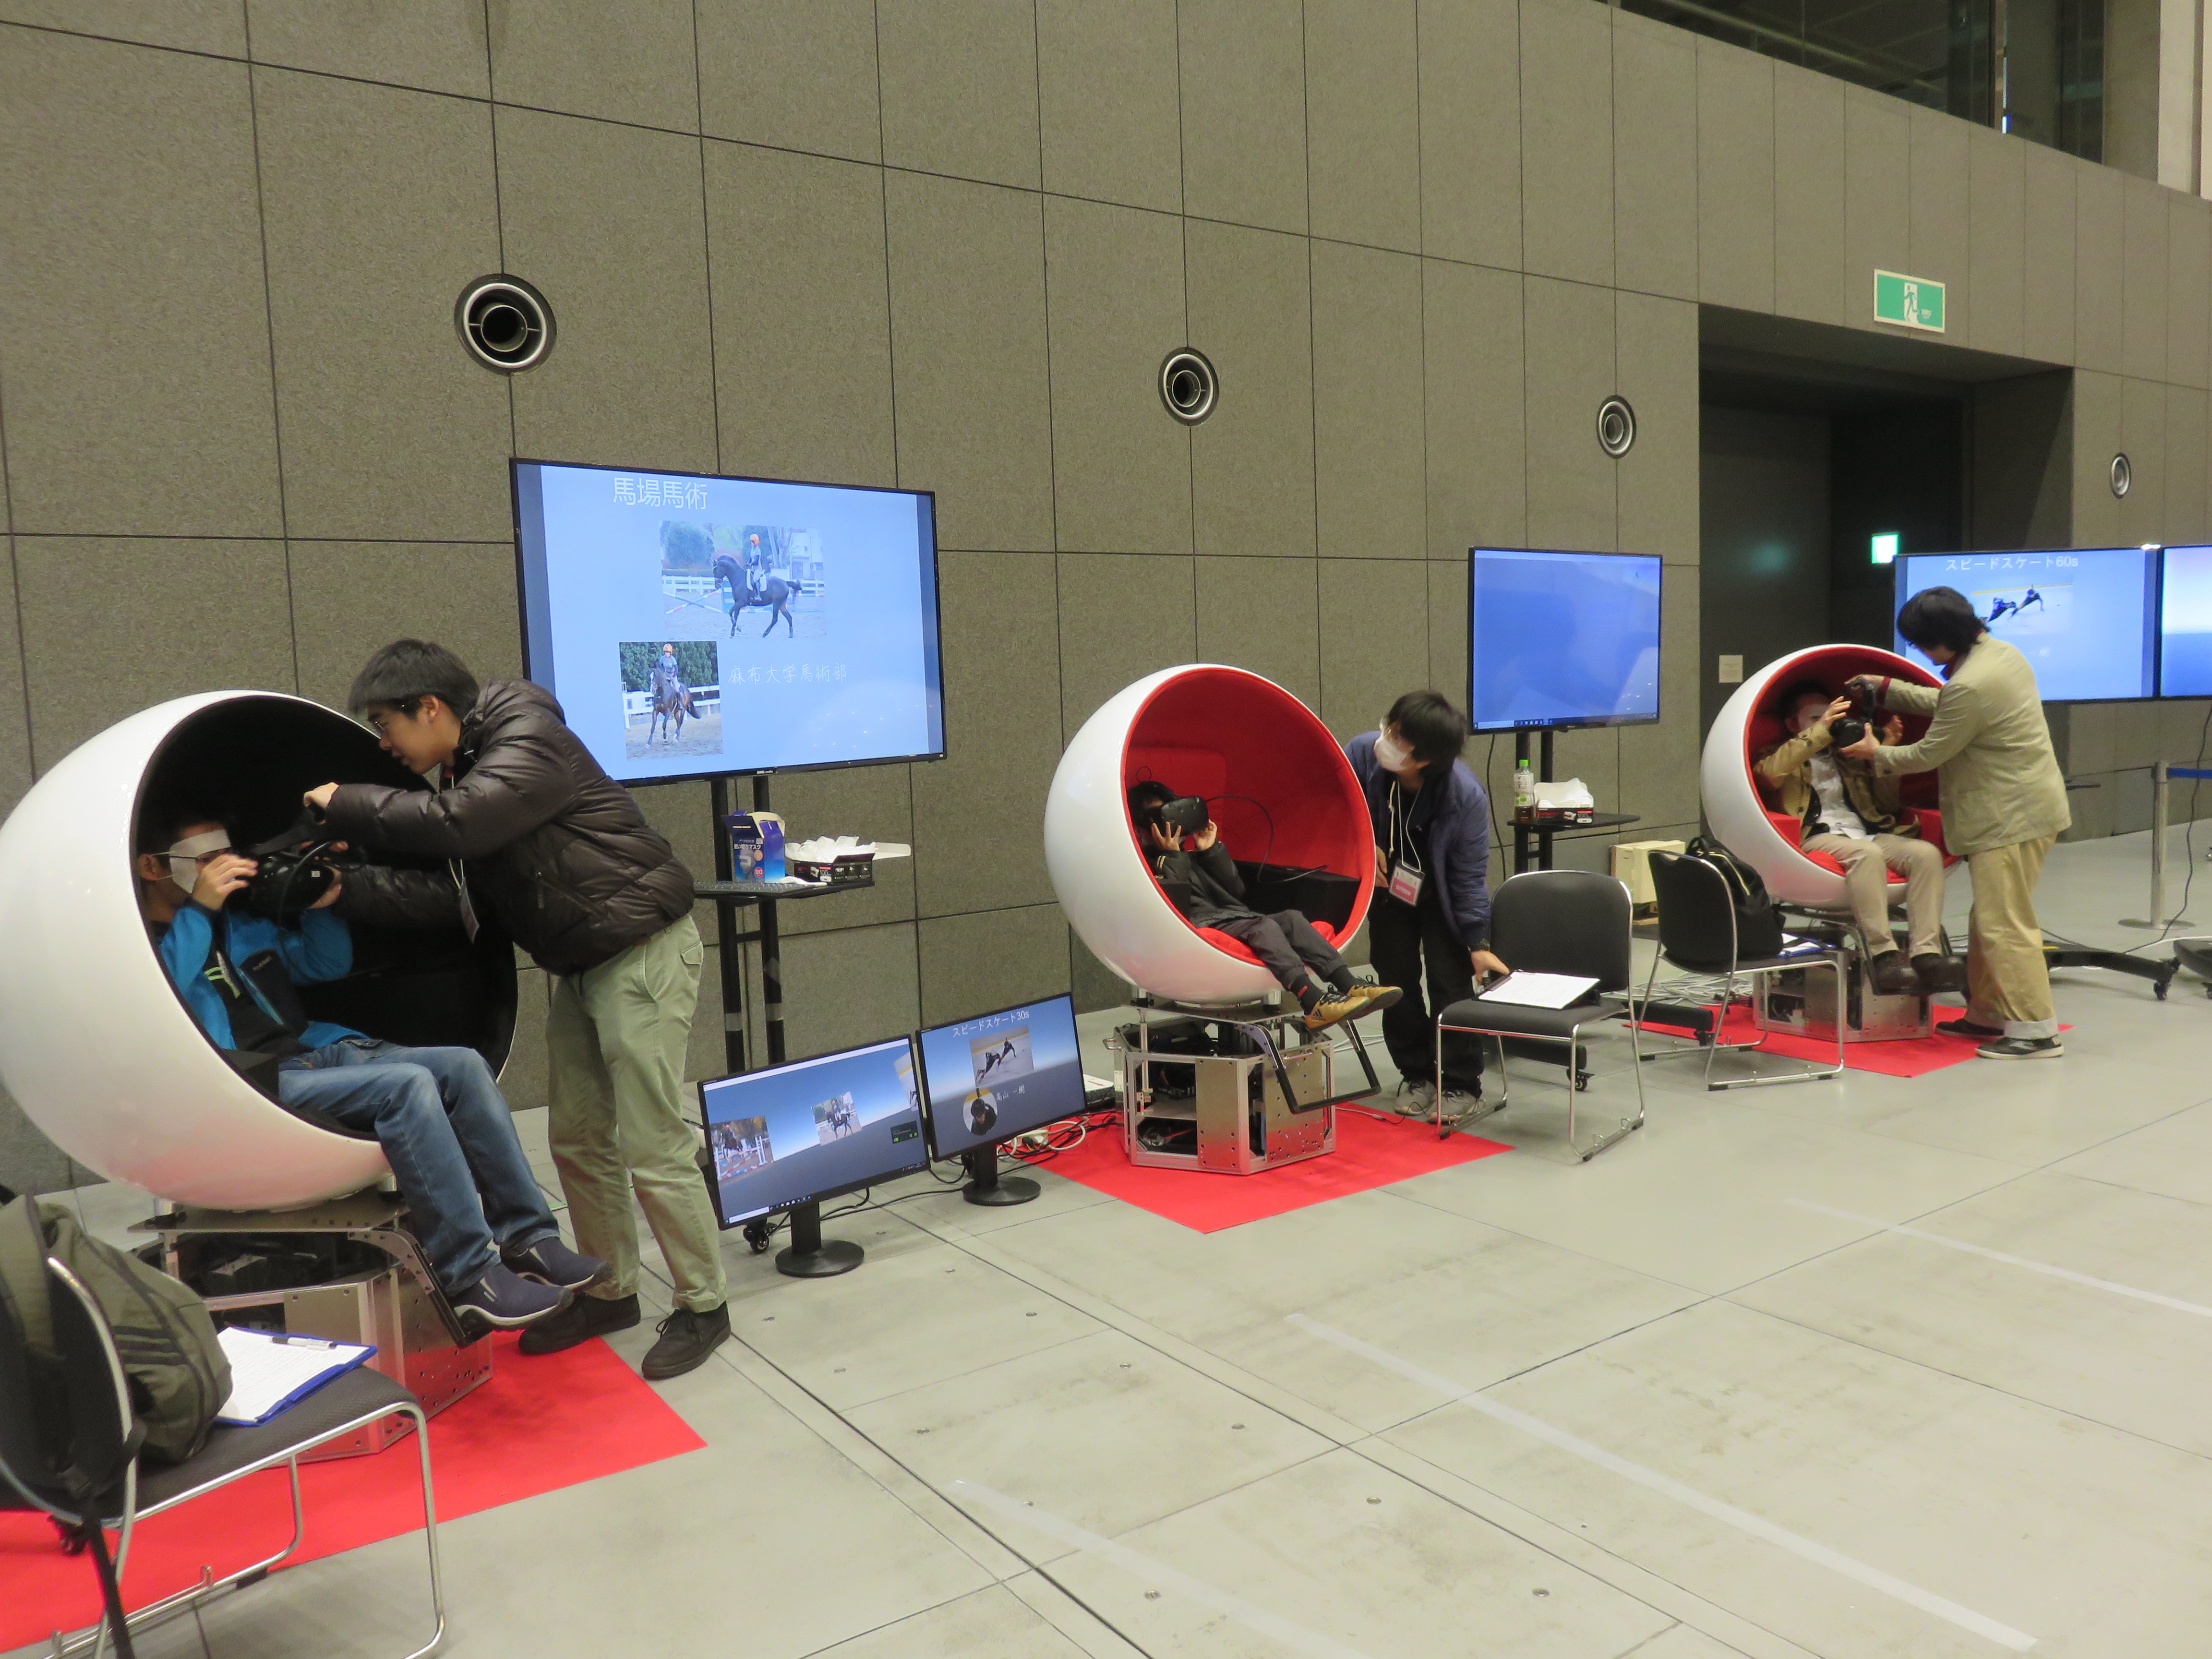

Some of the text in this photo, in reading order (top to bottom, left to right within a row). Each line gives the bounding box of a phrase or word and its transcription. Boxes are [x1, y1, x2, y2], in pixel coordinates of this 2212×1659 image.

[613, 477, 708, 510] 馬場馬術
[1946, 555, 2079, 571] スピードスケート60s
[727, 662, 847, 685] 麻布大学馬術部
[952, 1010, 1030, 1038] スピードスケート30s
